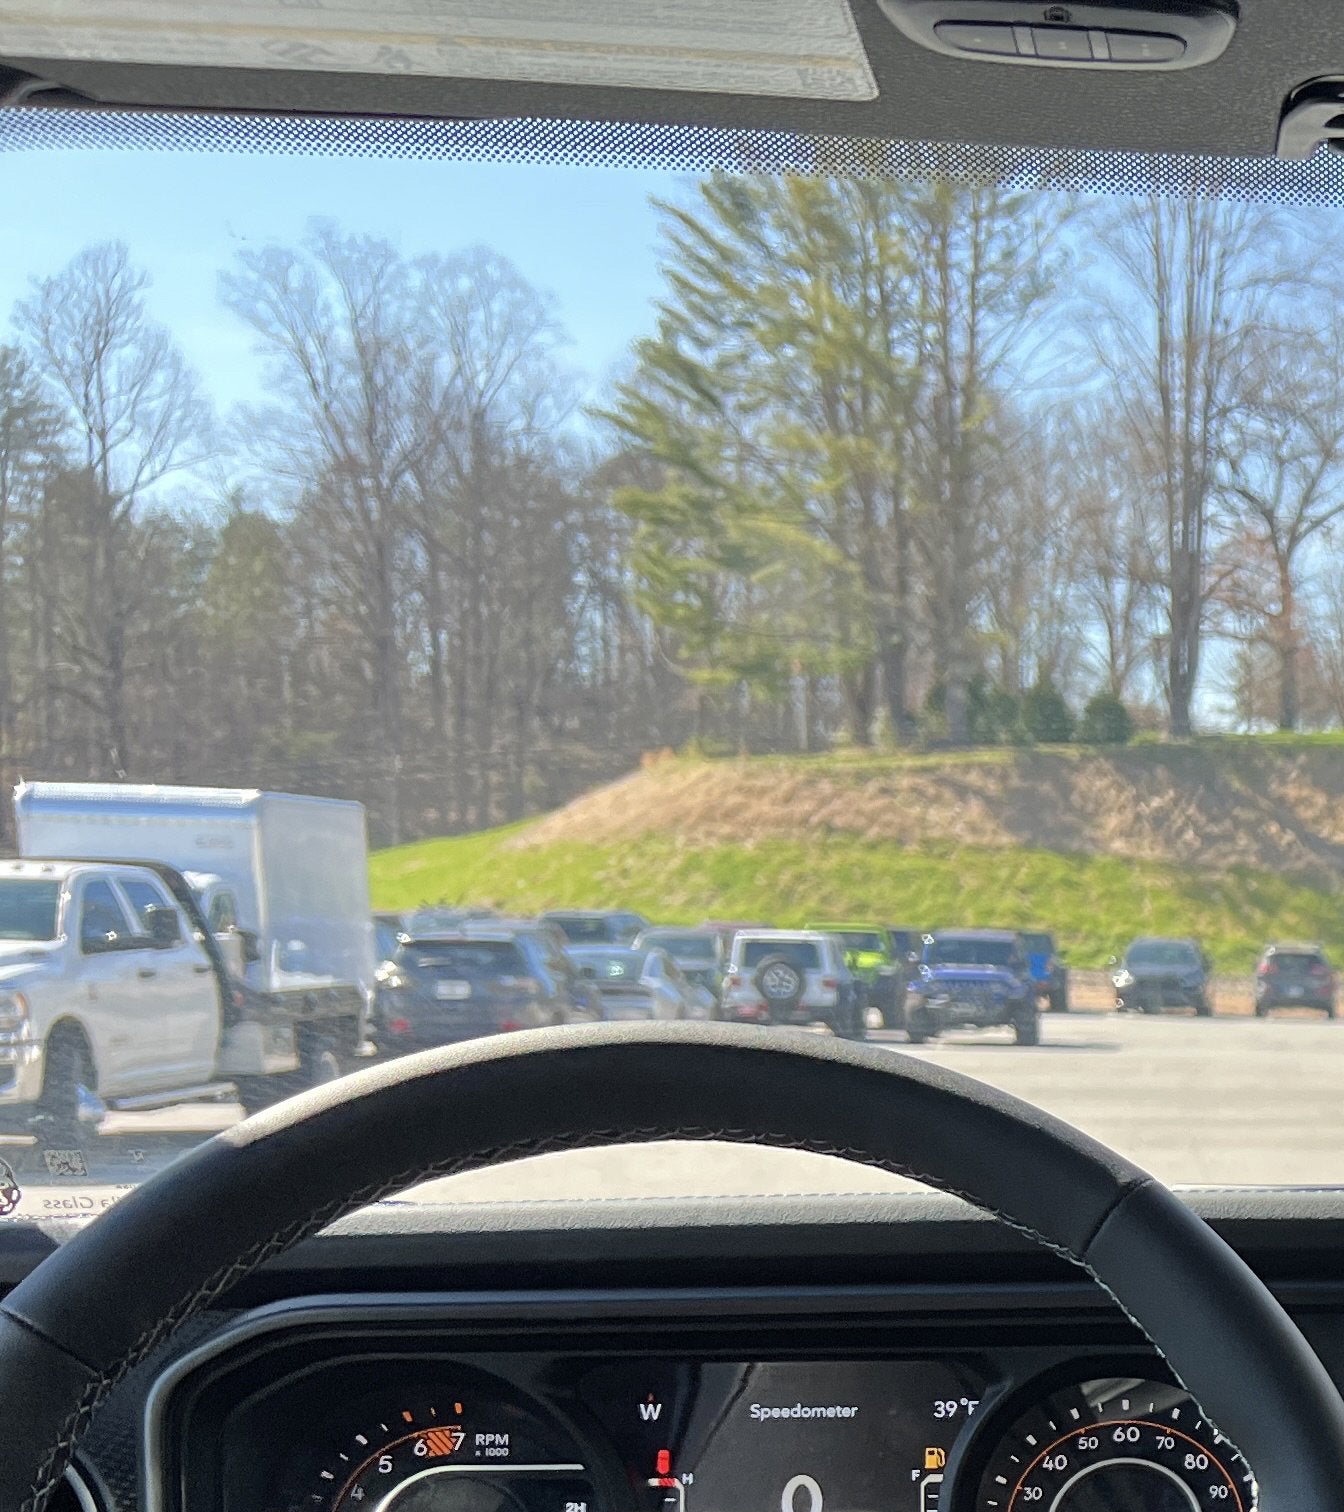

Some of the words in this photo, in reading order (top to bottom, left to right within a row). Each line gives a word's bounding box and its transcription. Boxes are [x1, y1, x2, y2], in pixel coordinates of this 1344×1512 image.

[639, 1403, 662, 1421] W
[749, 1403, 859, 1421] Speedometer
[452, 1433, 466, 1451] 7
[474, 1433, 510, 1446] RPM
[1078, 1436, 1099, 1450] 50
[1112, 1426, 1141, 1443] 60
[1155, 1436, 1175, 1450] 70
[413, 1440, 428, 1457] 6
[484, 1447, 510, 1457] 1000
[378, 1455, 393, 1474] 5
[1041, 1454, 1068, 1472] 40
[1183, 1453, 1209, 1470] 80
[682, 1472, 694, 1485] H
[911, 1469, 921, 1482] F
[350, 1484, 365, 1501] 4
[1023, 1486, 1043, 1501] 30
[1208, 1485, 1229, 1499] 90
